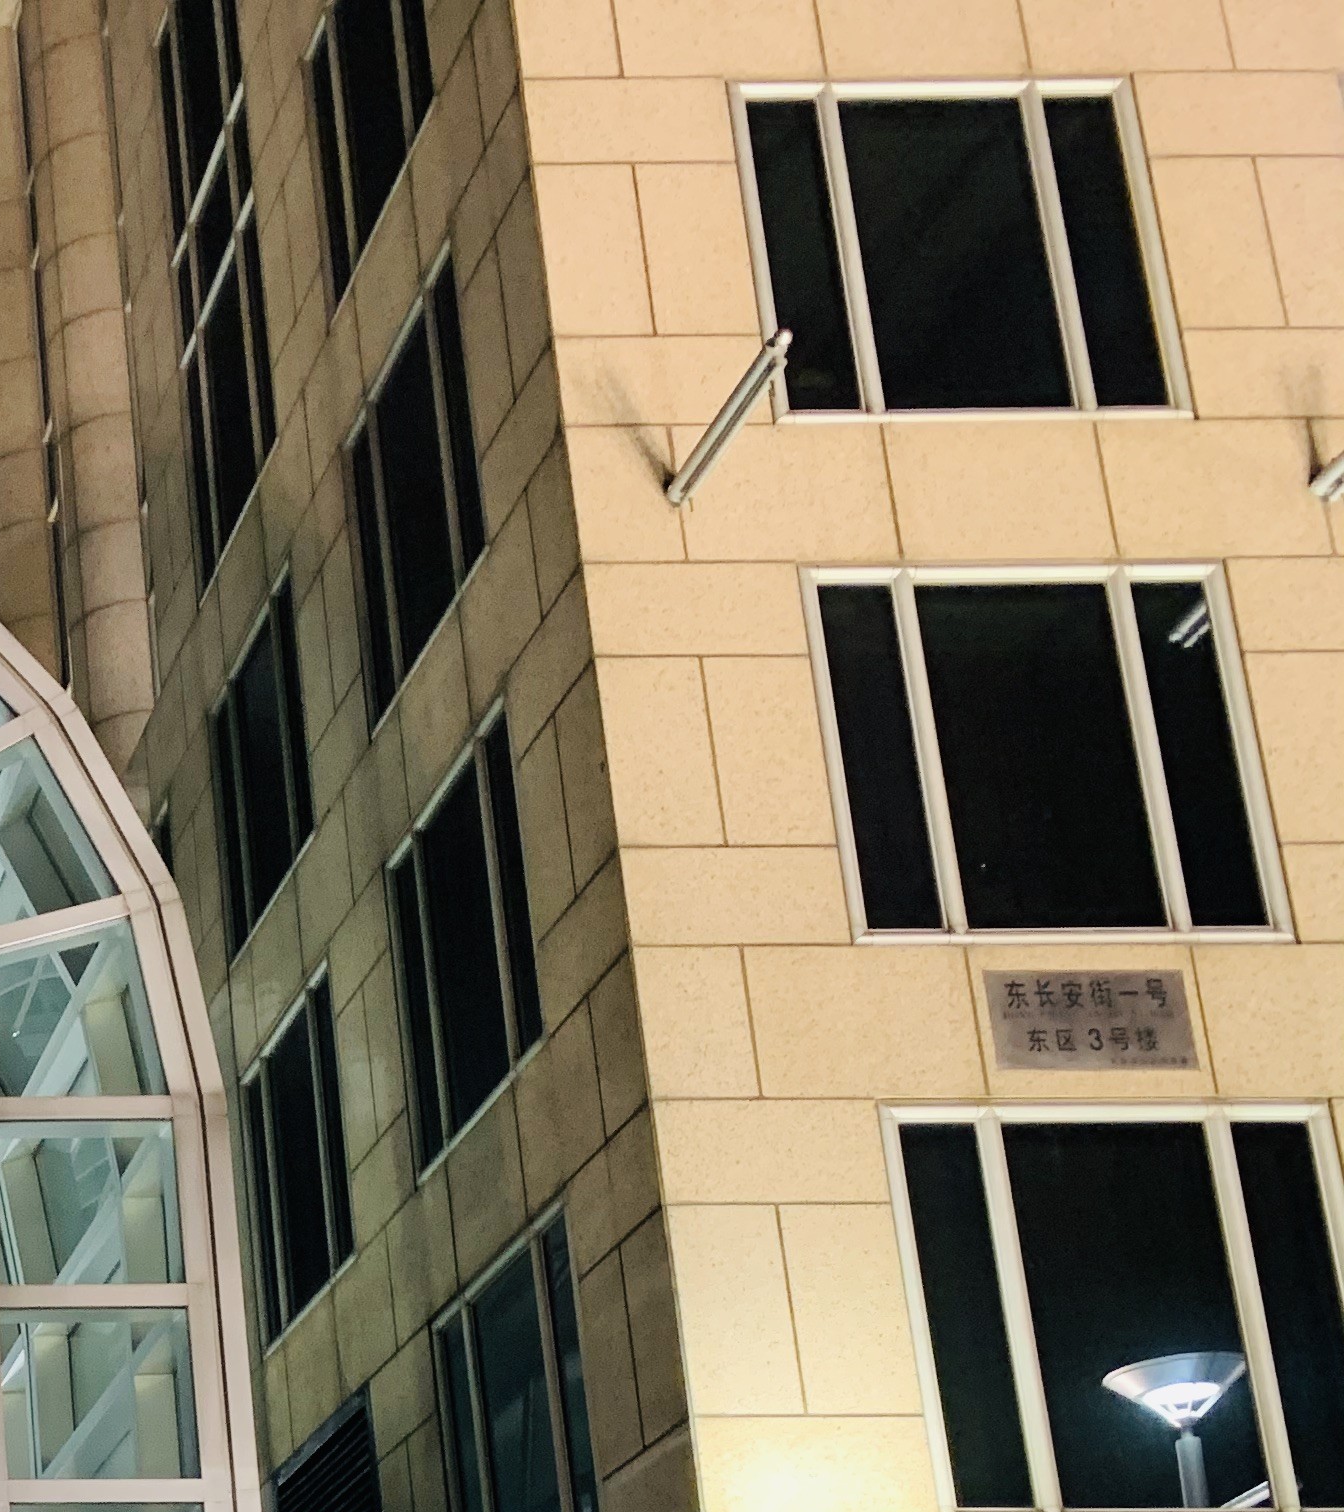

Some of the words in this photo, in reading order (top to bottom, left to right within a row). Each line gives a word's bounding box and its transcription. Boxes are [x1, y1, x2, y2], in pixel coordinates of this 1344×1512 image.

[1003, 978, 1169, 1009] 东长安街一号
